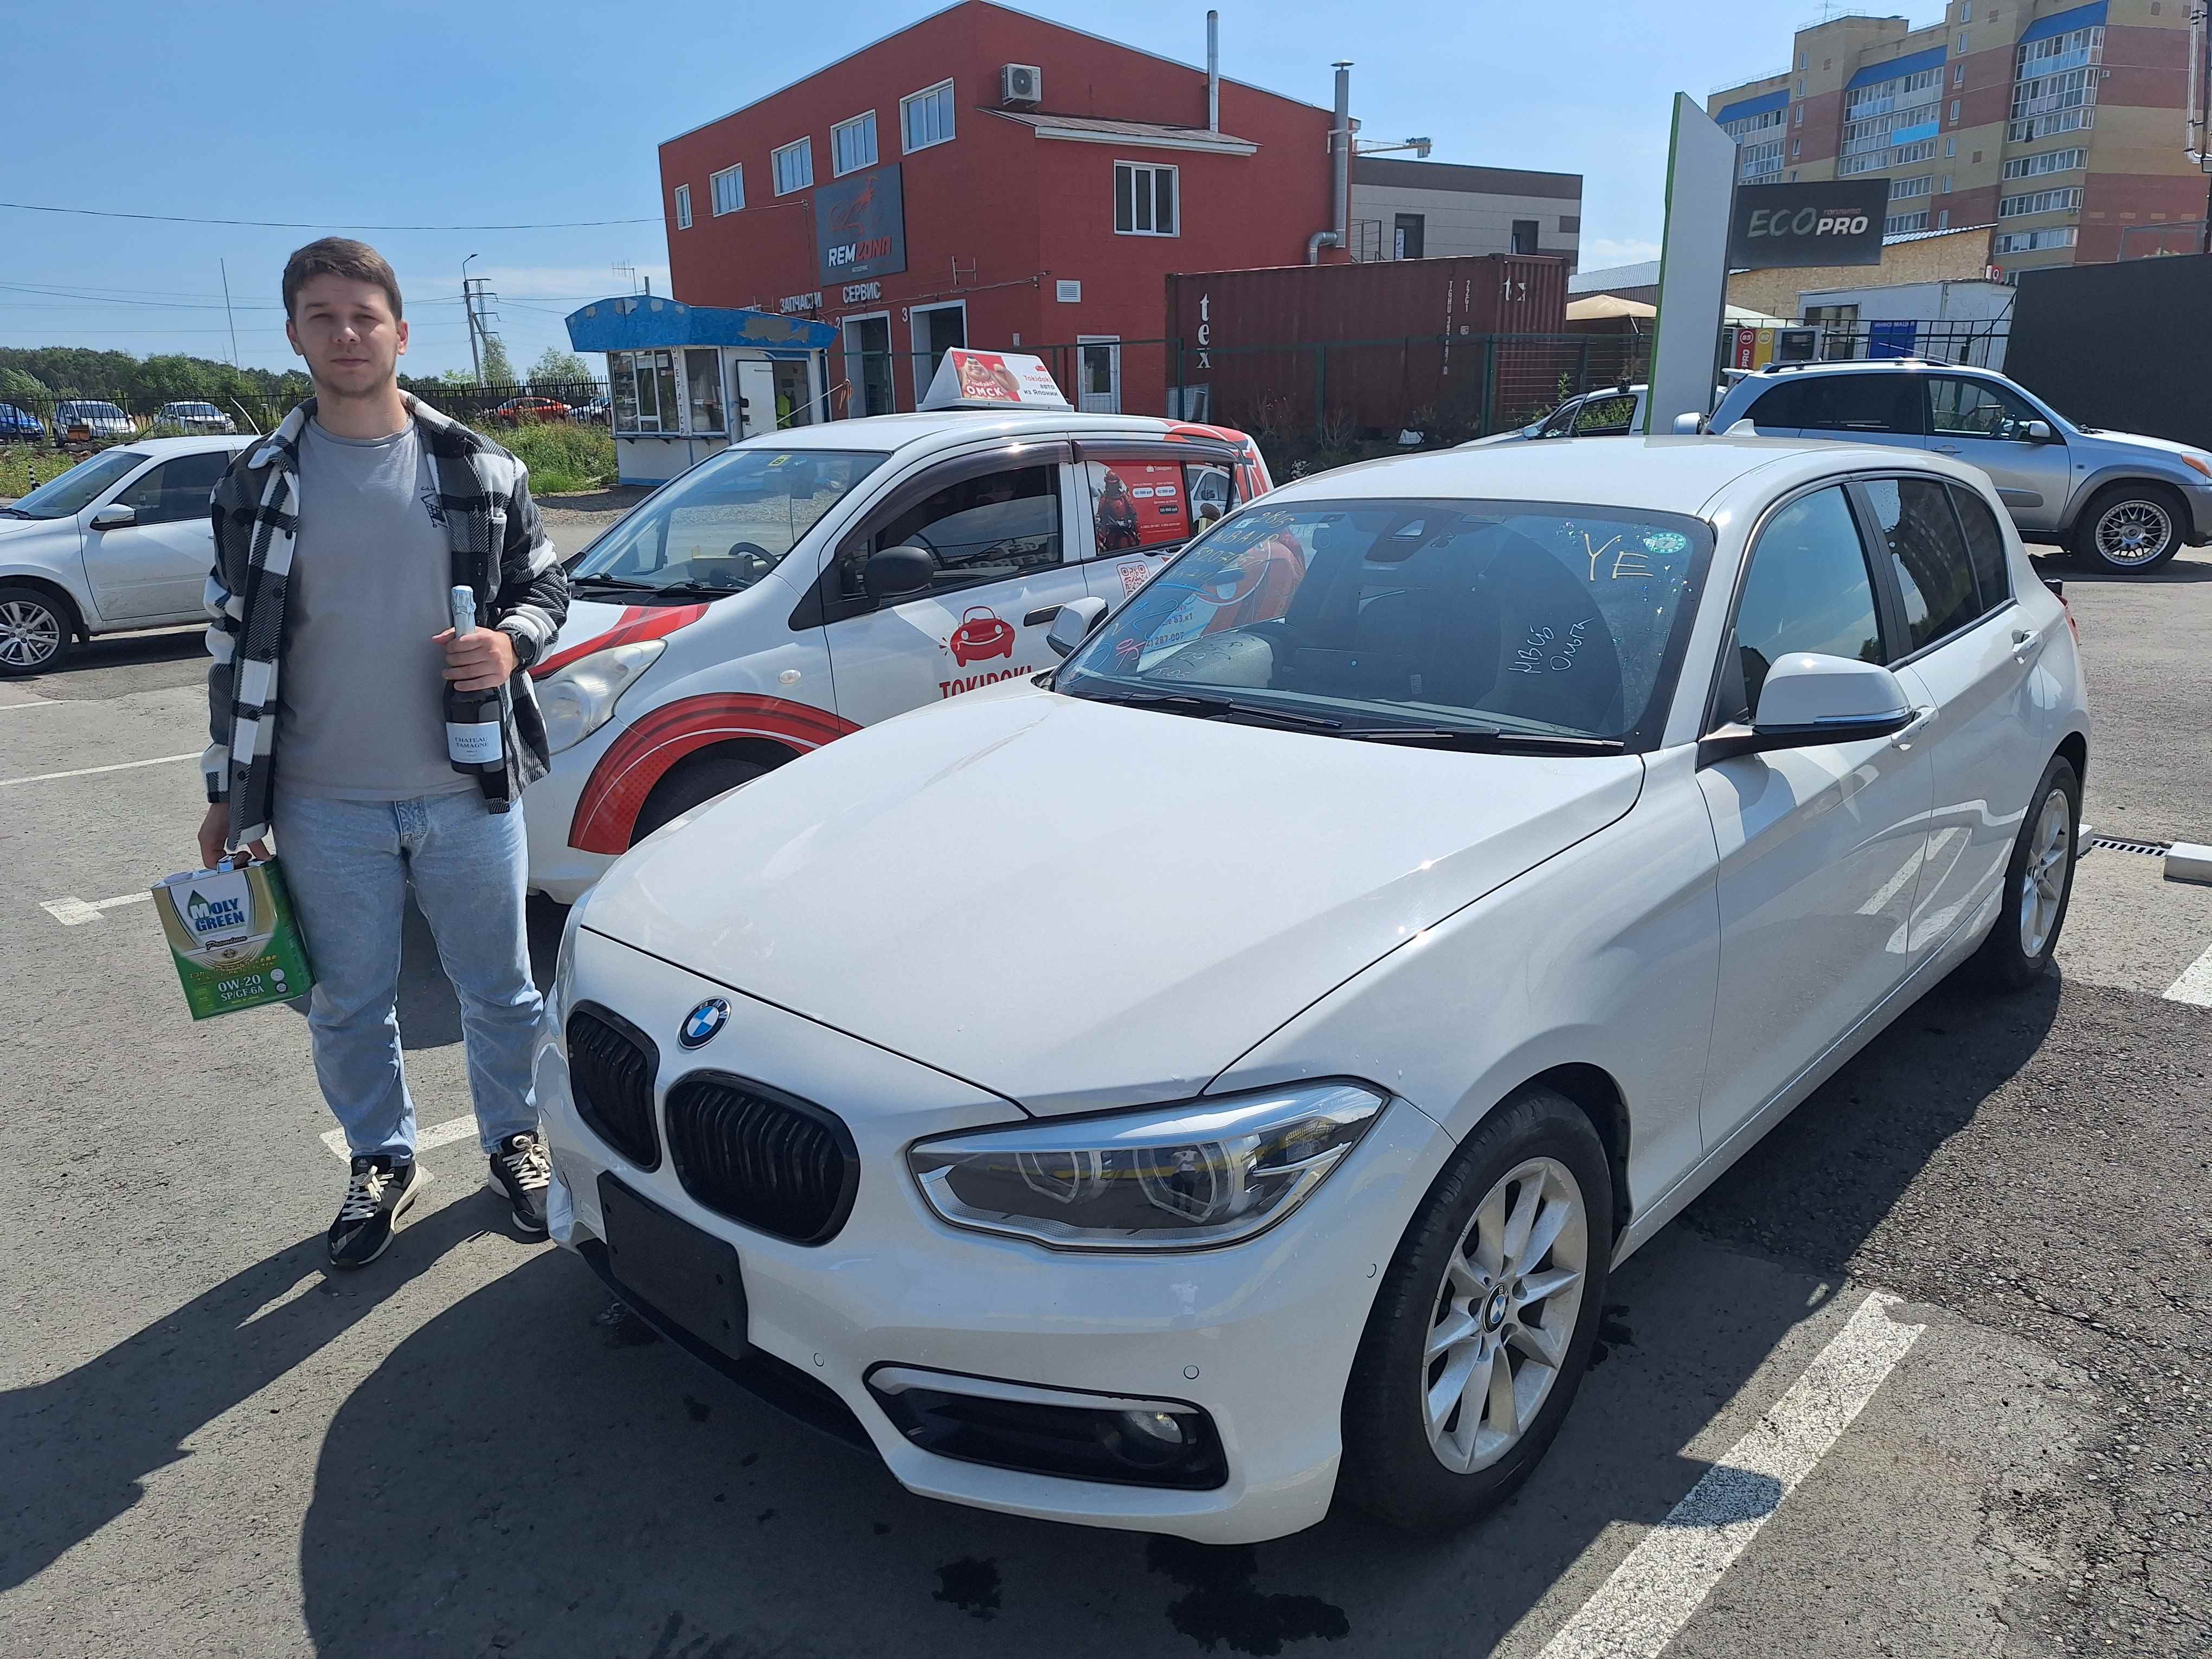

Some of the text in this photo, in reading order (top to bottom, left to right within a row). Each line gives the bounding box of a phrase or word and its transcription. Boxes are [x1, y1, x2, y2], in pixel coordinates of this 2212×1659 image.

[1747, 207, 1869, 238] ECO PRO
[780, 292, 824, 314] ЗАПЧАСТИ
[843, 282, 882, 304] СЕРВИС
[902, 307, 908, 322] 3
[1196, 293, 1211, 369] tex
[1741, 349, 1750, 367] PRO
[966, 385, 1005, 396] ОМСК
[190, 898, 239, 920] MOLY
[195, 911, 245, 932] GREEN
[218, 974, 261, 993] 0W-20
[221, 985, 265, 1002] SP/GF-6A
